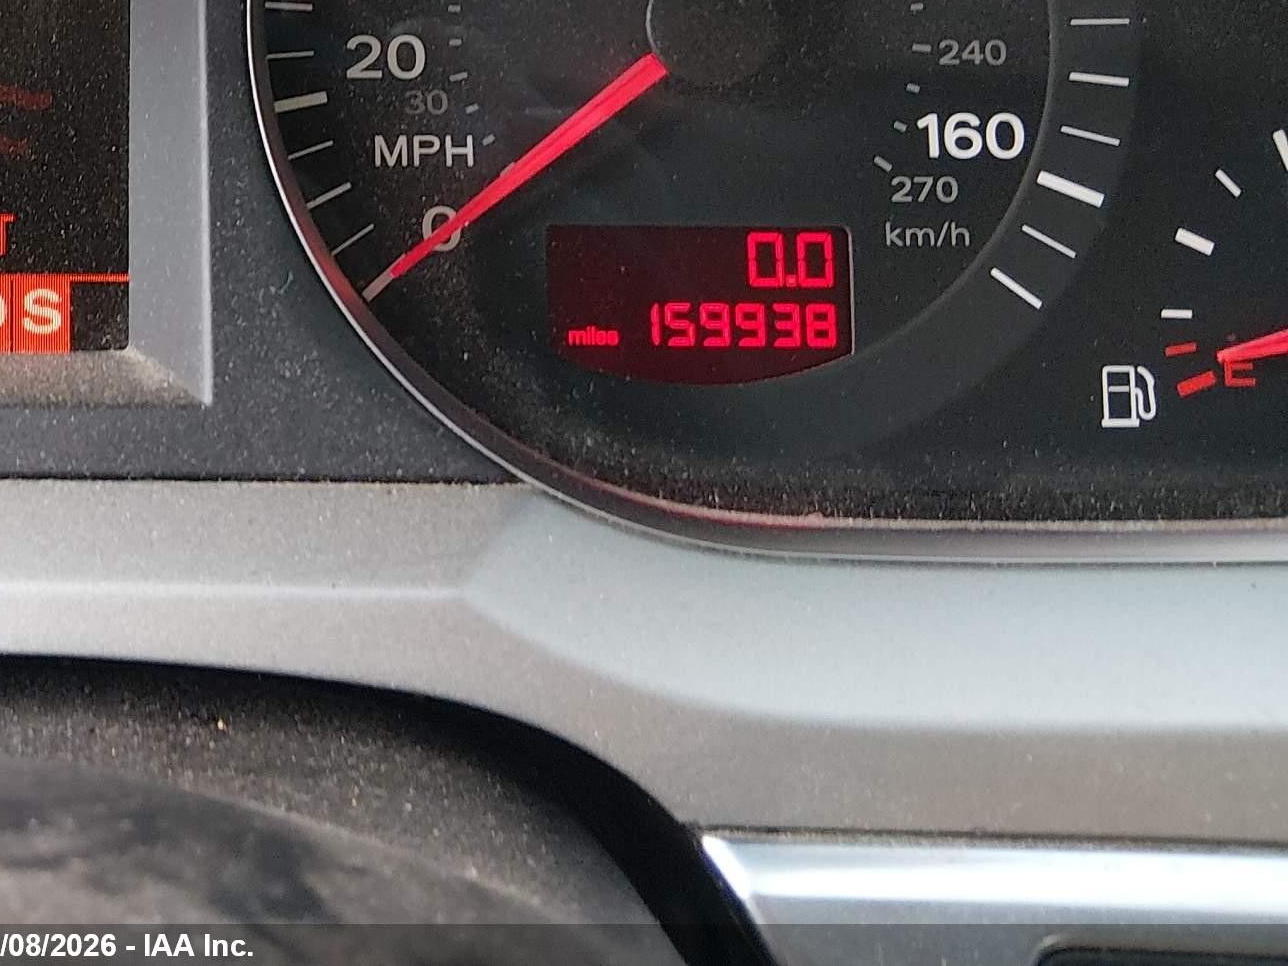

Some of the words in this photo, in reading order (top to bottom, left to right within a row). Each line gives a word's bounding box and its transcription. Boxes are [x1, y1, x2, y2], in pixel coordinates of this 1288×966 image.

[347, 35, 425, 78] 20
[939, 39, 1006, 65] 240
[406, 90, 448, 114] 30
[375, 135, 473, 166] MPH
[917, 113, 1024, 159] 160
[892, 177, 958, 202] 270
[422, 205, 462, 251] 0
[886, 221, 969, 247] km/h
[747, 231, 834, 288] 0.0
[568, 326, 620, 346] miles
[650, 302, 837, 348] 159938
